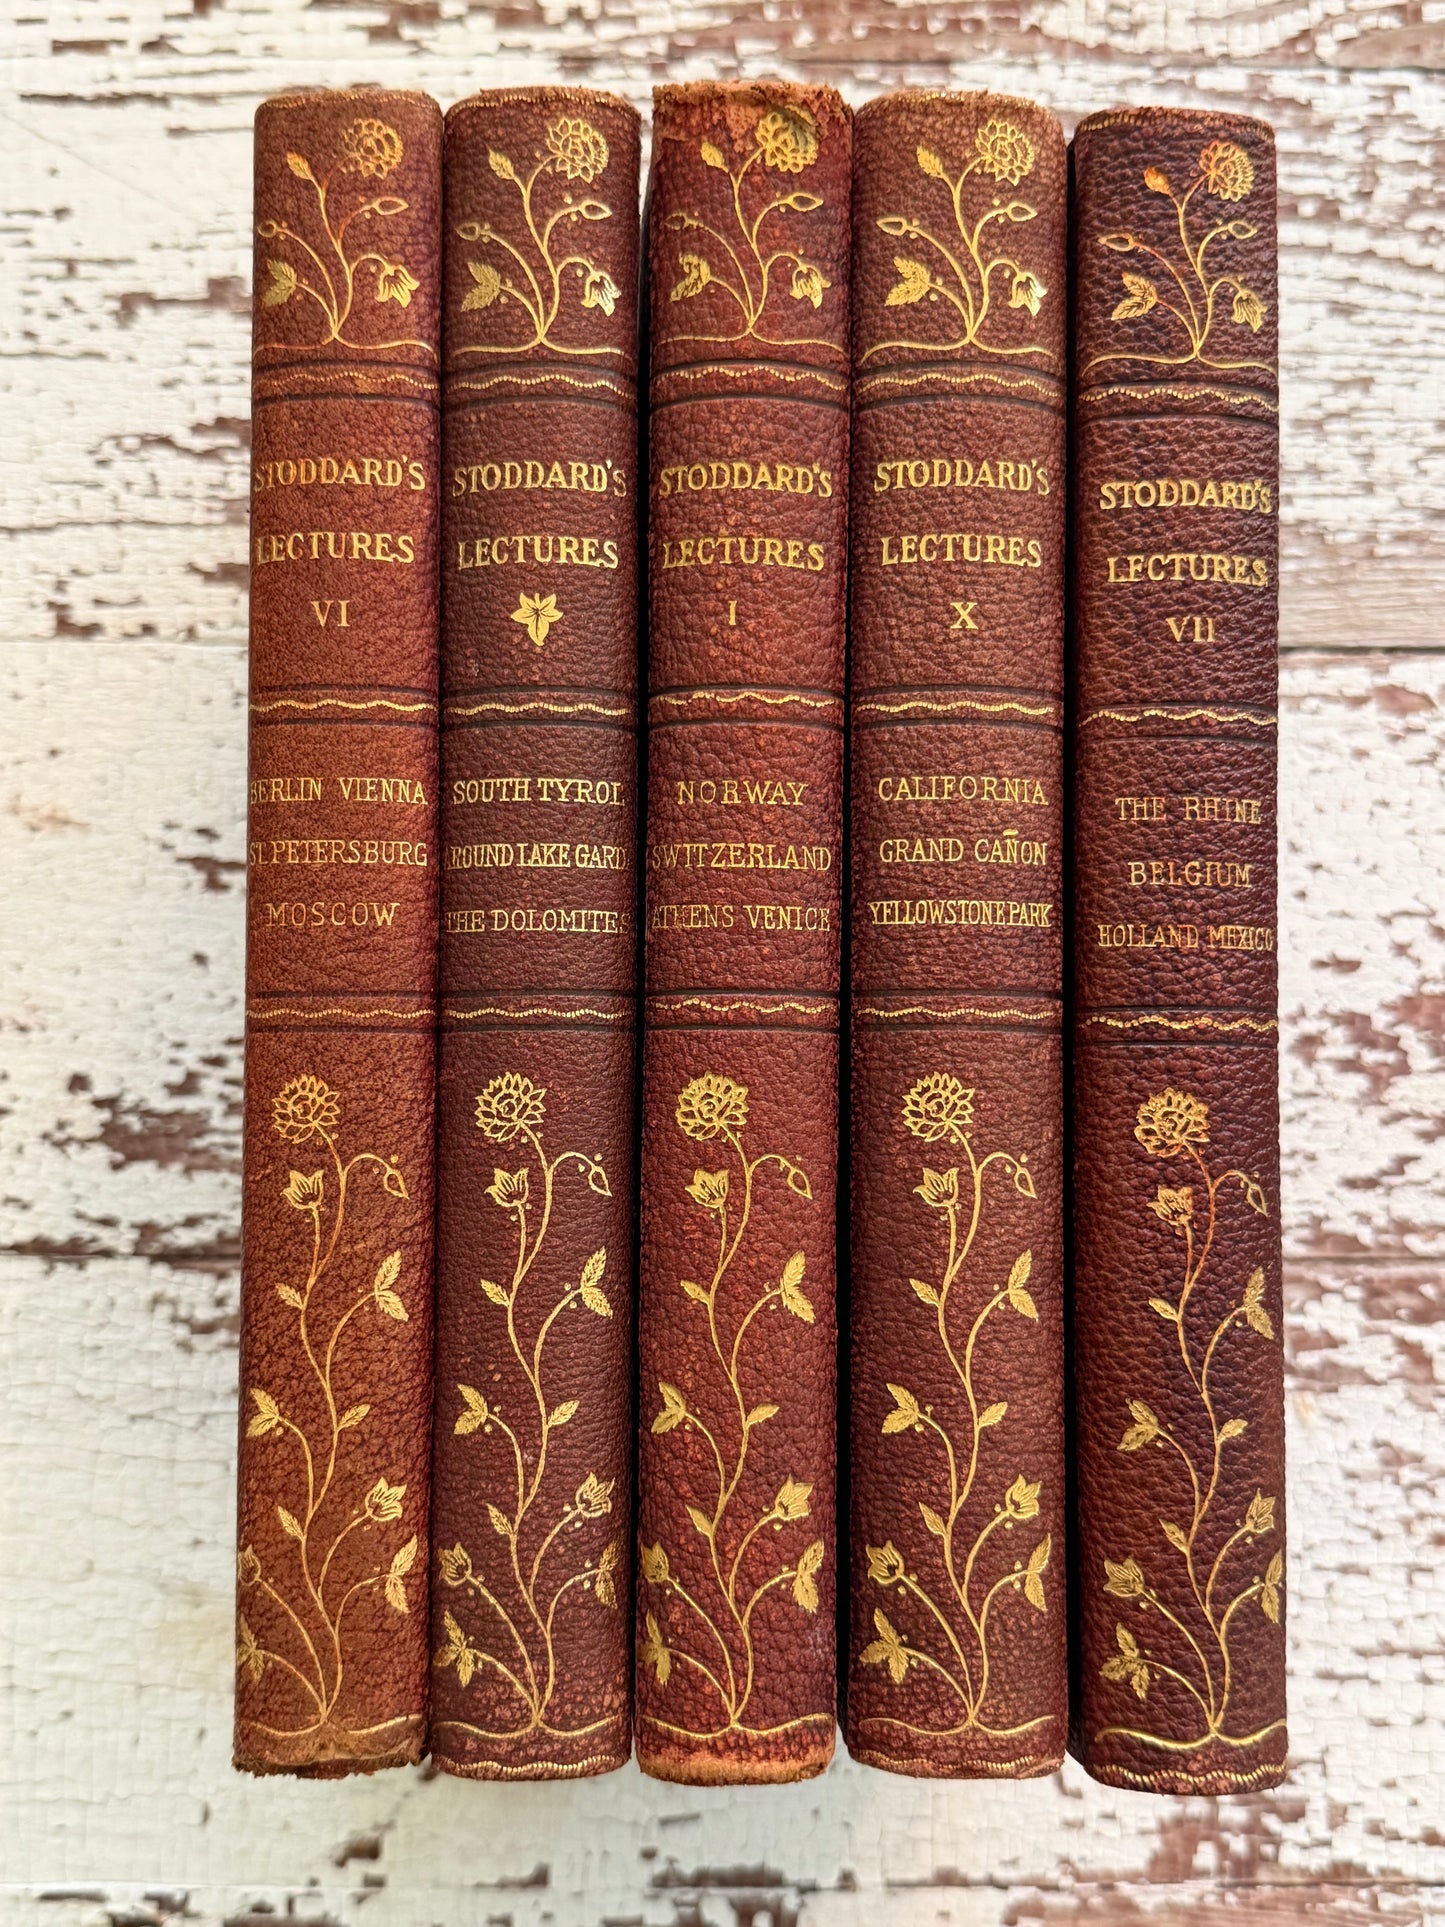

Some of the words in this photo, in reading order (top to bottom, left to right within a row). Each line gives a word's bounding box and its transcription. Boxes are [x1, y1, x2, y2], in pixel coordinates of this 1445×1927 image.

[254, 455, 426, 492] STODDARD'S
[452, 460, 627, 497] STODDARD'S
[659, 461, 832, 497] STODDARD'S
[874, 459, 1050, 496] STODDARD'S
[1100, 479, 1272, 513] STODDARD'S
[256, 532, 415, 565] LECTURES
[458, 535, 619, 570] LECTURES
[663, 536, 825, 571] LECTURES
[881, 534, 1042, 568] LECTURES
[1107, 553, 1269, 587] LECTURES
[311, 601, 351, 627] VI
[728, 600, 738, 626] I
[950, 601, 979, 629] X
[1166, 615, 1216, 643] VII
[250, 777, 324, 804] BERLIN
[337, 777, 429, 805] VIENNA
[453, 777, 532, 805] SOUTH
[537, 777, 625, 806] TYROL
[676, 780, 809, 806] NORWAY
[878, 775, 1050, 806] CALIFORNIA
[1115, 797, 1167, 821] THE
[1183, 796, 1262, 825] RHINE
[516, 842, 571, 868] LAKE
[652, 842, 832, 871] SWITZERLAND
[879, 837, 964, 863] GRAND
[974, 828, 1048, 866] CAÑON
[1127, 861, 1253, 888] BELGIUM
[265, 901, 401, 927] MOSCOW
[445, 910, 486, 934] THE
[491, 908, 631, 935] DOLOMITES
[652, 904, 734, 930] ATHENS
[743, 904, 831, 932] VENICE
[1007, 902, 1053, 928] PARK
[1097, 923, 1199, 948] HOLLAND
[1207, 924, 1274, 951] MEXICO
